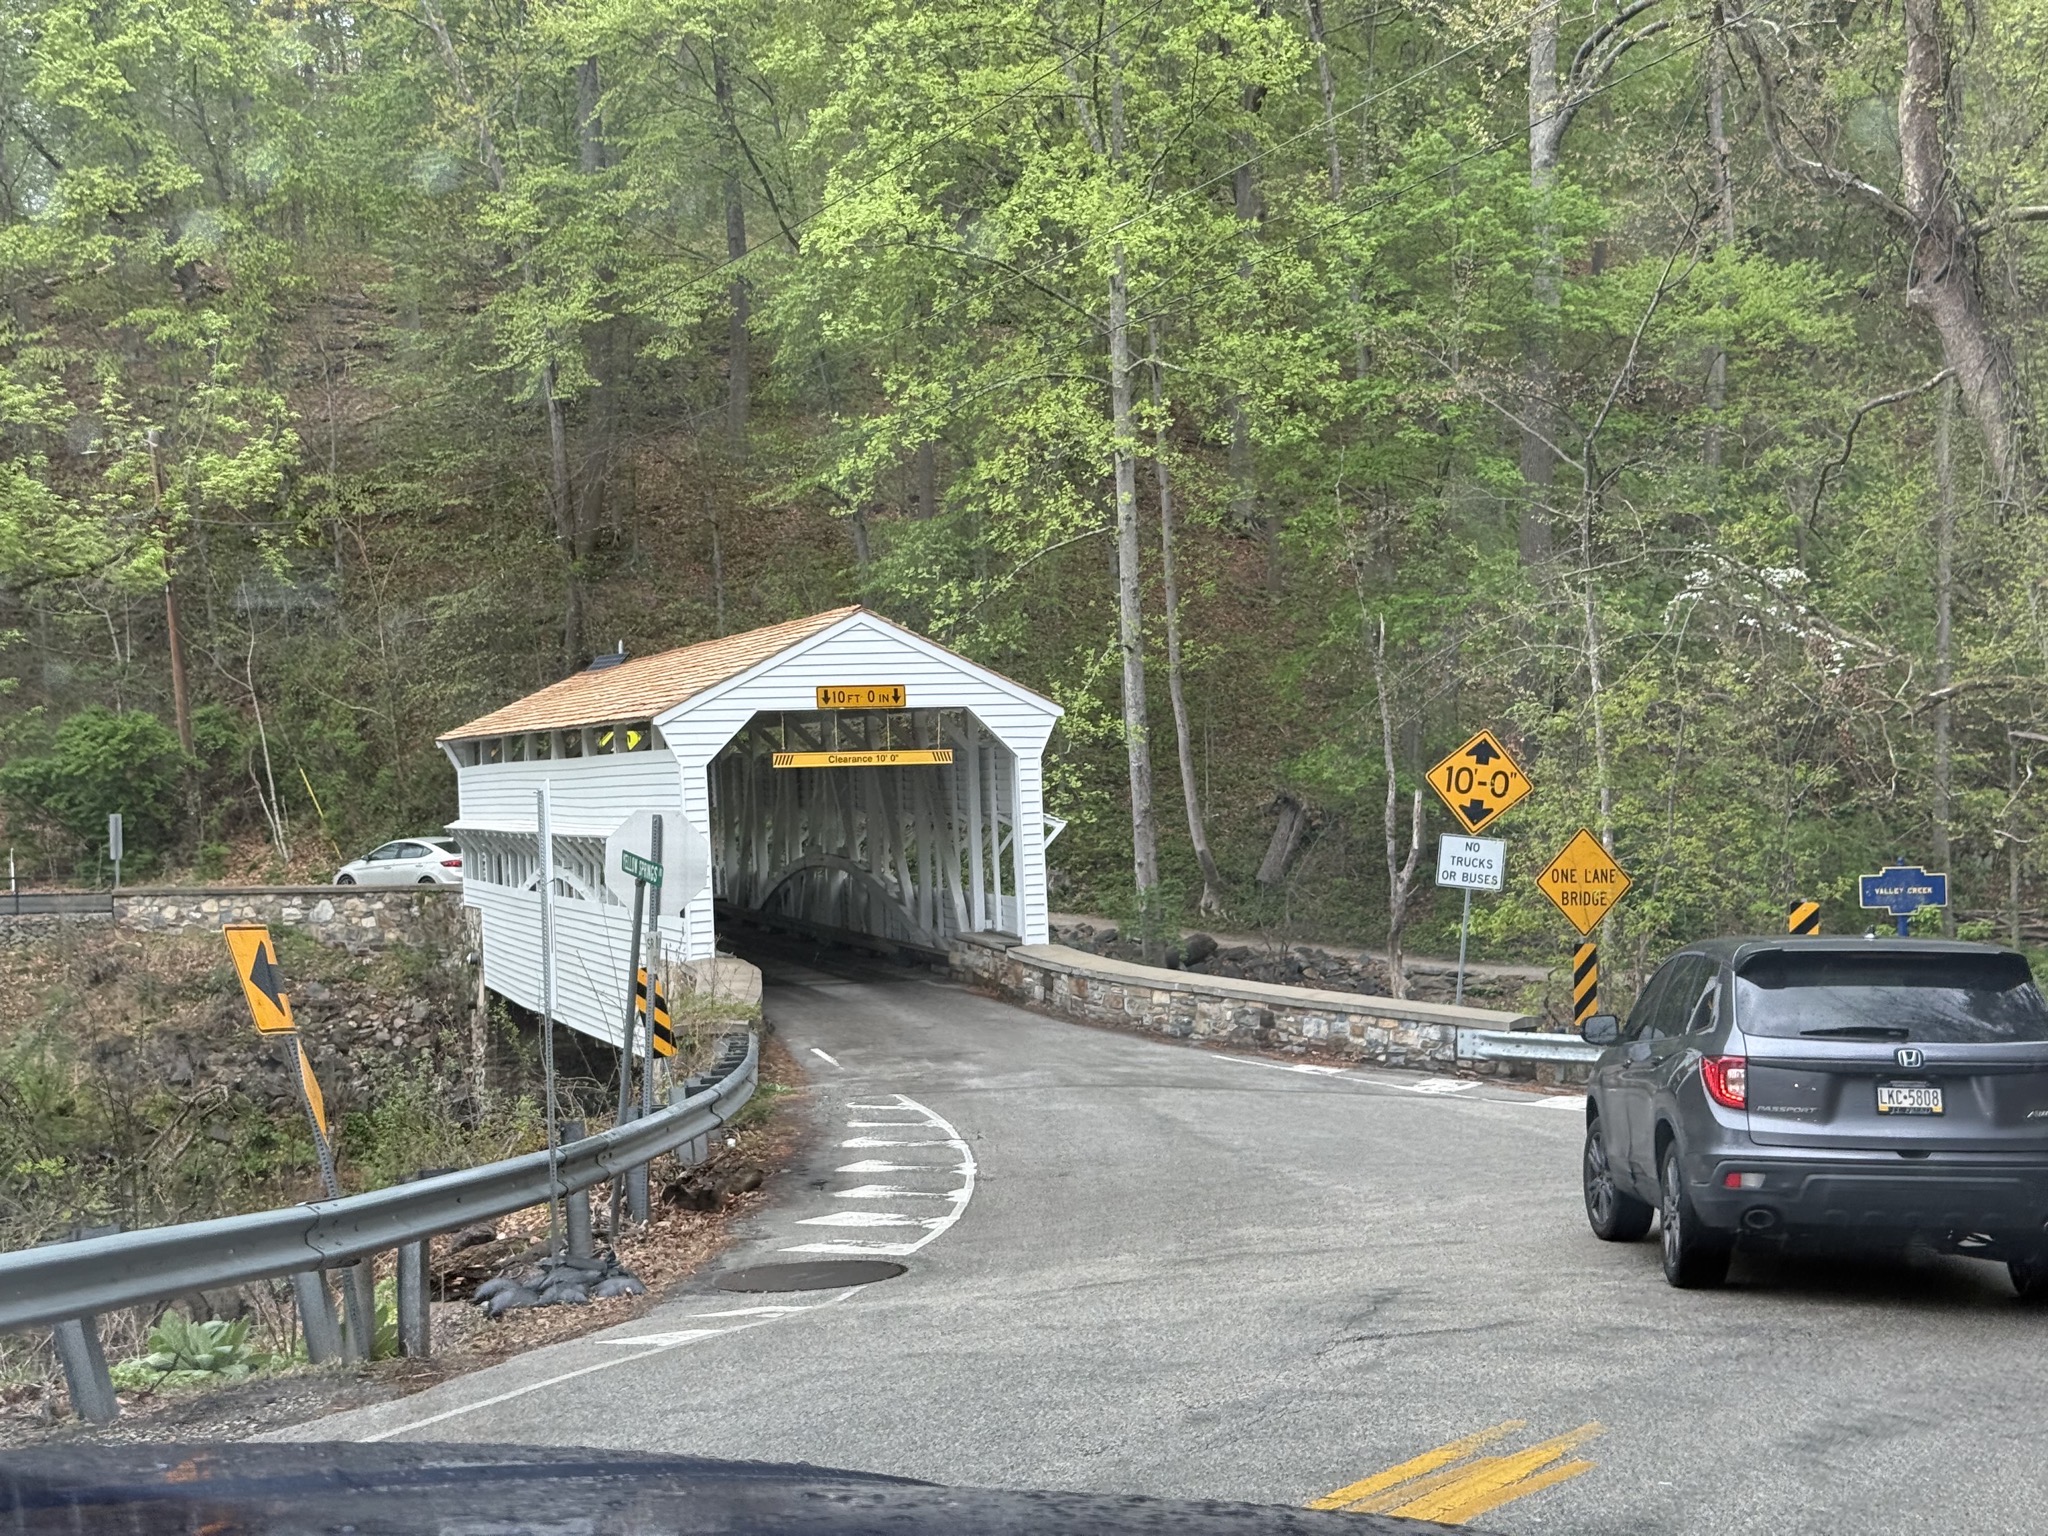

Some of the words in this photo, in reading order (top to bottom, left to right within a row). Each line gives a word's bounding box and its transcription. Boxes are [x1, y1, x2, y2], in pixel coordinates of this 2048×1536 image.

[879, 694, 889, 703] IN
[828, 755, 873, 764] Clearance
[1465, 841, 1481, 853] NO
[1450, 855, 1493, 869] TRUCKS
[1441, 870, 1457, 881] OR
[1462, 872, 1498, 885] BUSES
[1551, 868, 1577, 884] ONE
[1584, 868, 1616, 884] LANE
[1874, 887, 1904, 895] VALLEY
[1907, 886, 1933, 894] CREEK
[1561, 891, 1608, 907] BRIDGE
[1757, 1105, 1818, 1114] PASSPORT
